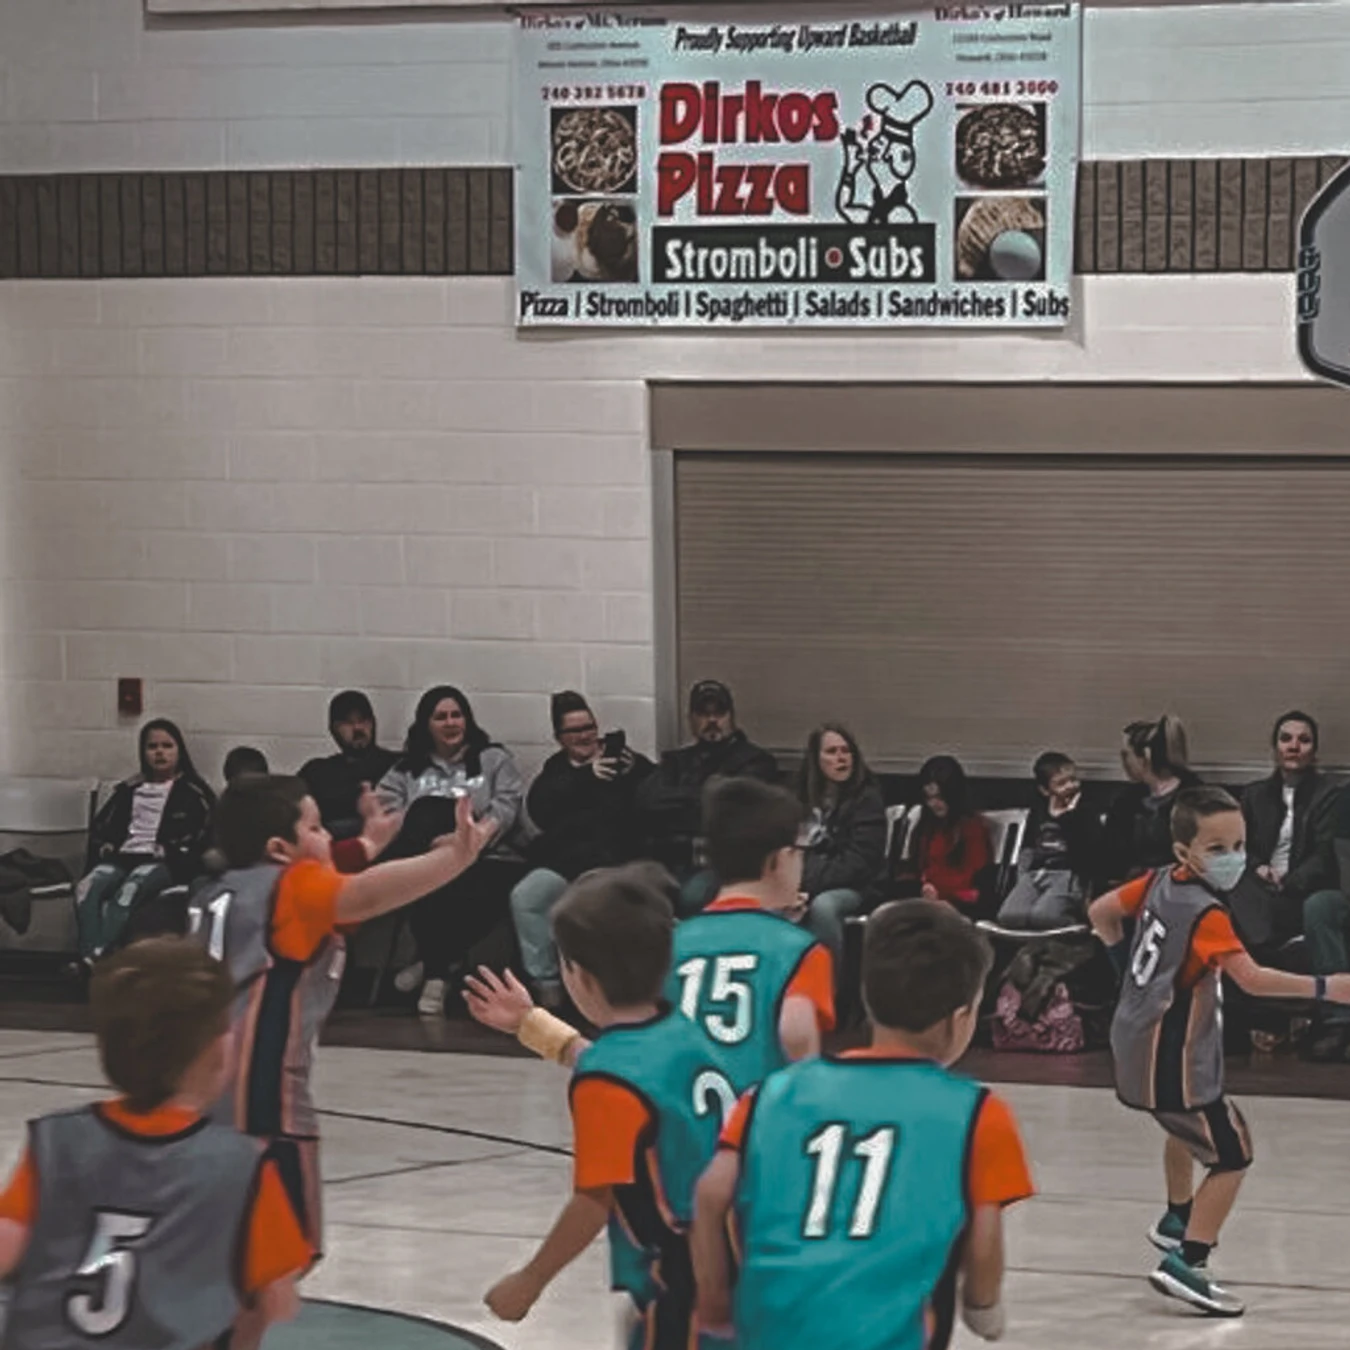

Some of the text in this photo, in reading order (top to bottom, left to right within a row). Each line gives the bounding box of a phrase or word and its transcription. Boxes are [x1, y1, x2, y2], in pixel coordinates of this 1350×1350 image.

[726, 25, 796, 52] Supporting
[848, 22, 918, 46] Basketball
[659, 80, 840, 146] Dirkos
[657, 151, 810, 217] Pizza
[664, 236, 924, 279] Stromboli Subs
[520, 289, 1069, 321] Pizza Stromboli Spaghetti Salads Sandwiches Subs
[677, 955, 758, 1043] 15
[803, 1123, 895, 1238] 11
[66, 1211, 154, 1335] 5
